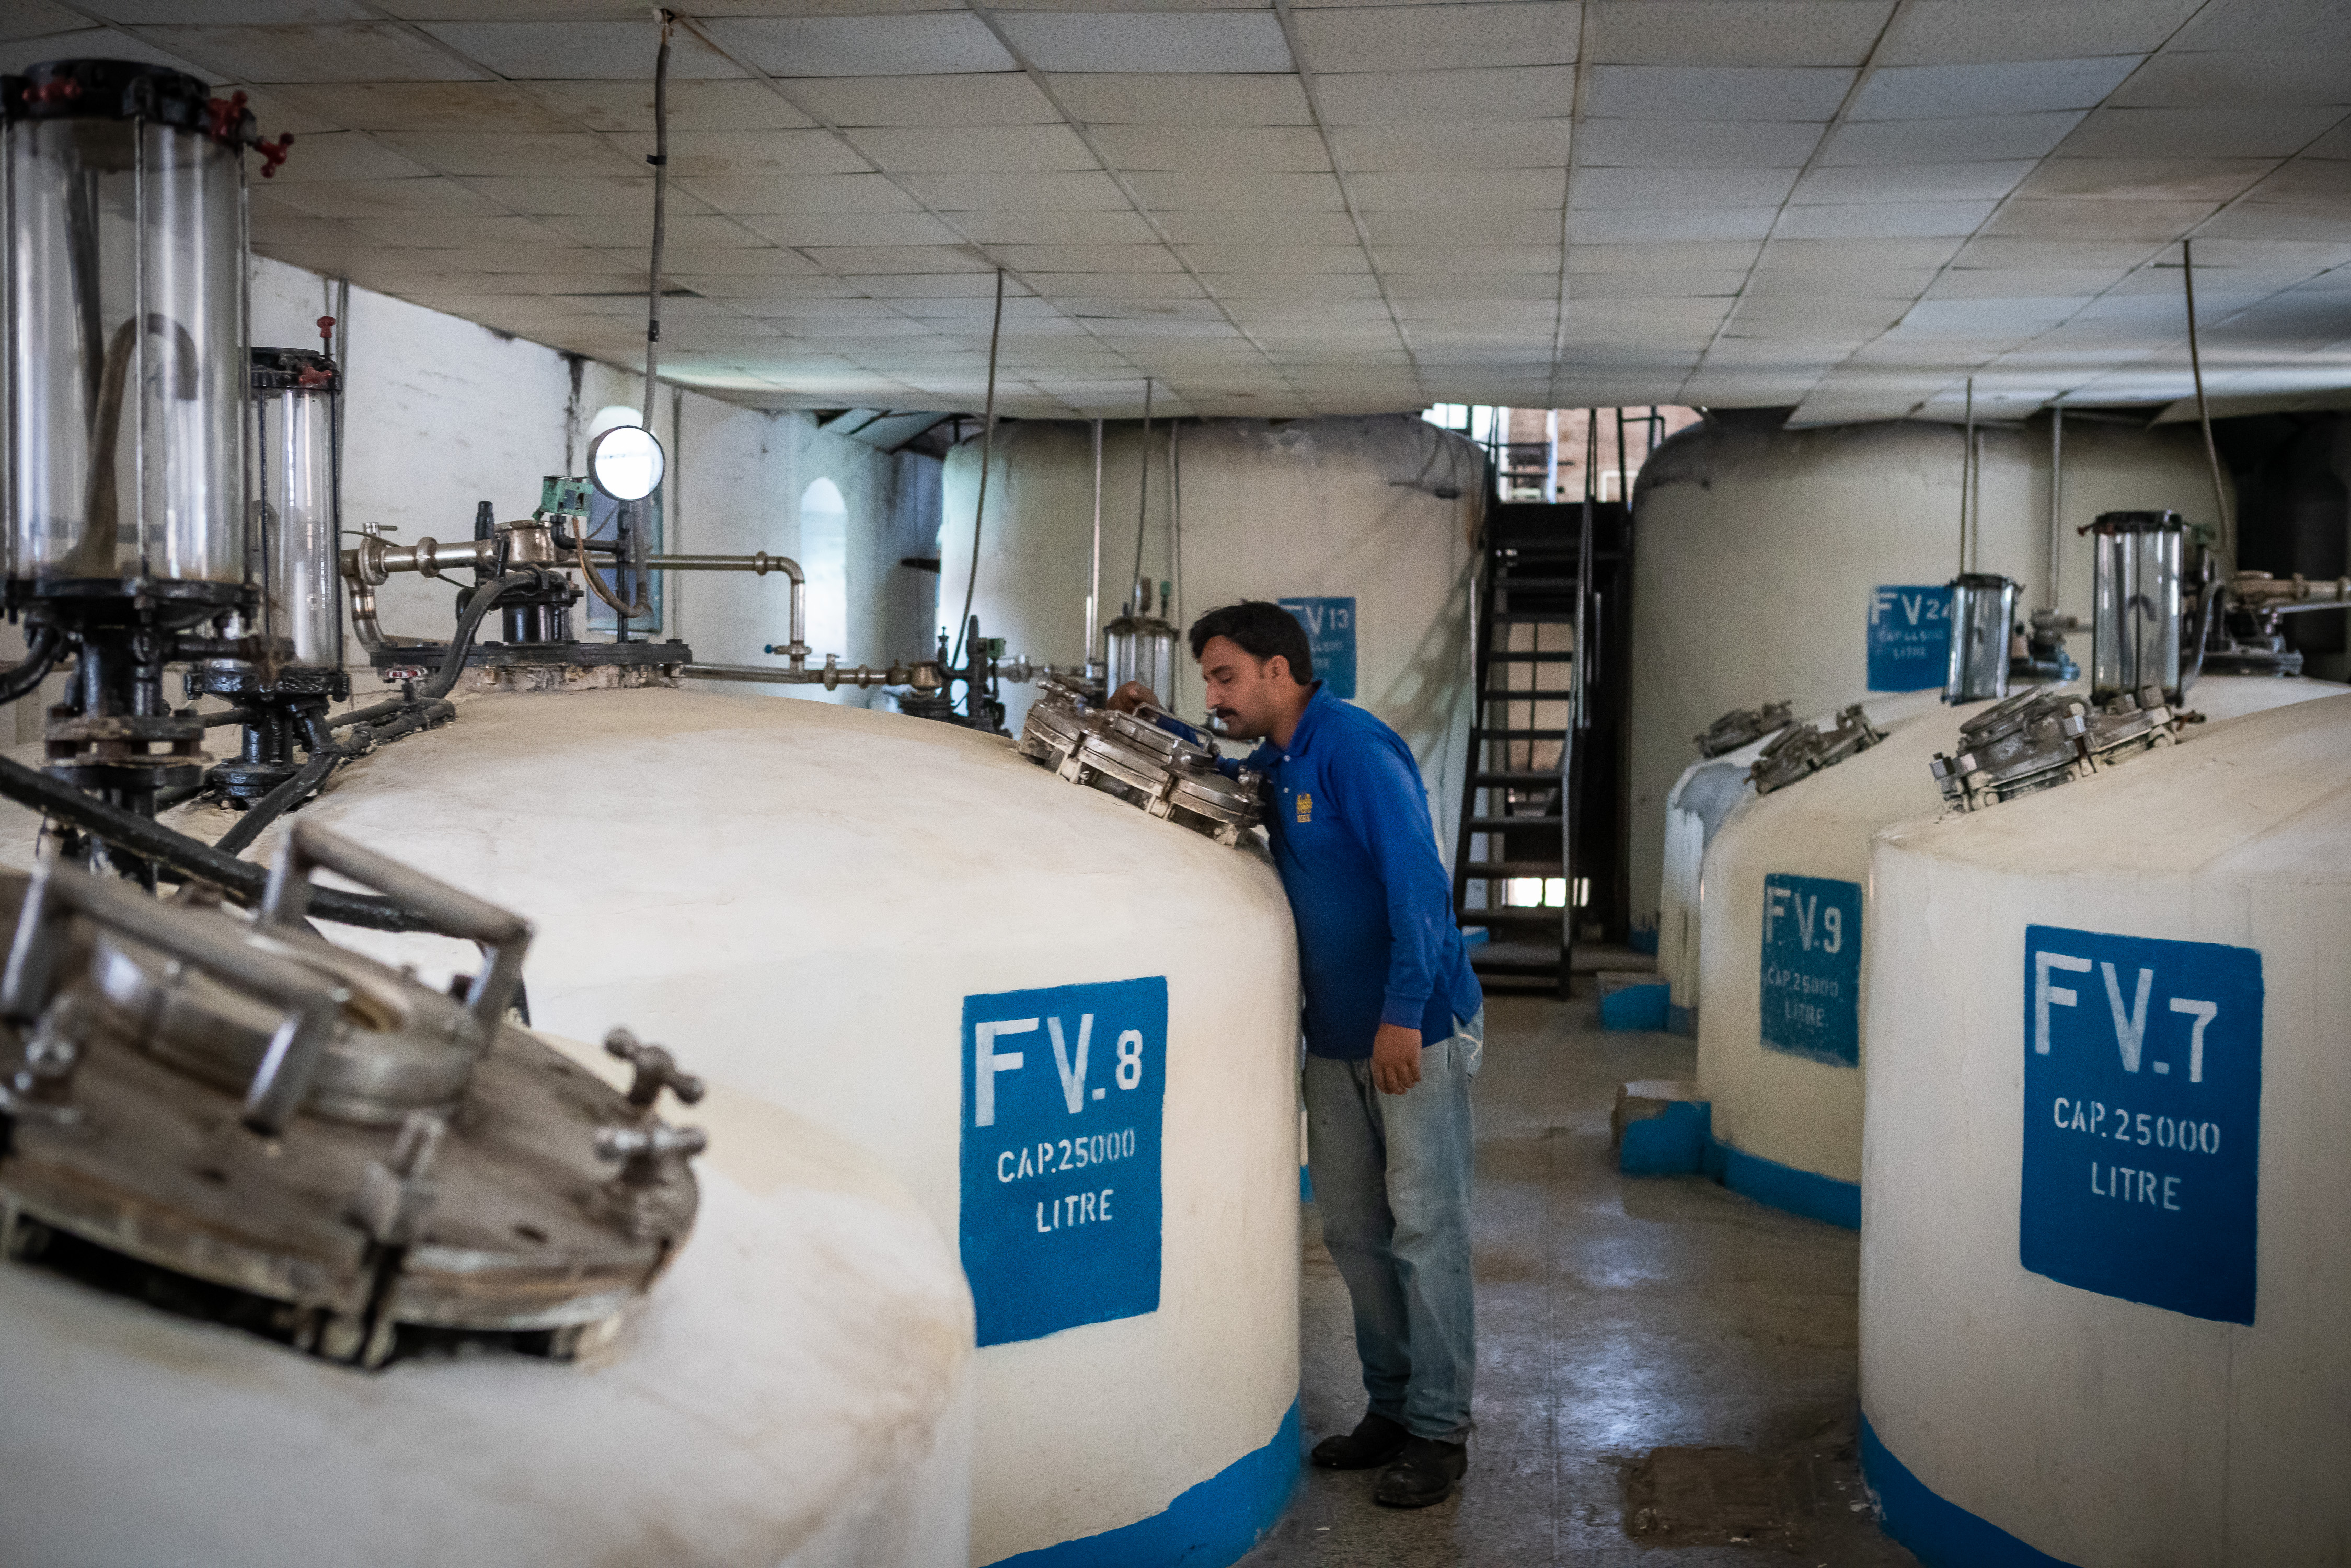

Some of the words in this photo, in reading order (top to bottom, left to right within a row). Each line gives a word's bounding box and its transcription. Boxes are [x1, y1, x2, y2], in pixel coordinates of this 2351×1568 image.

[1784, 999, 1825, 1027] LITRE
[2034, 950, 2218, 1083] FV.7
[975, 1013, 1143, 1127] FV.8
[2053, 1097, 2221, 1155] CAP.25000
[997, 1127, 1136, 1183] CAP.25000
[1036, 1189, 1114, 1233] LITRE
[2091, 1161, 2182, 1211] LITRE
